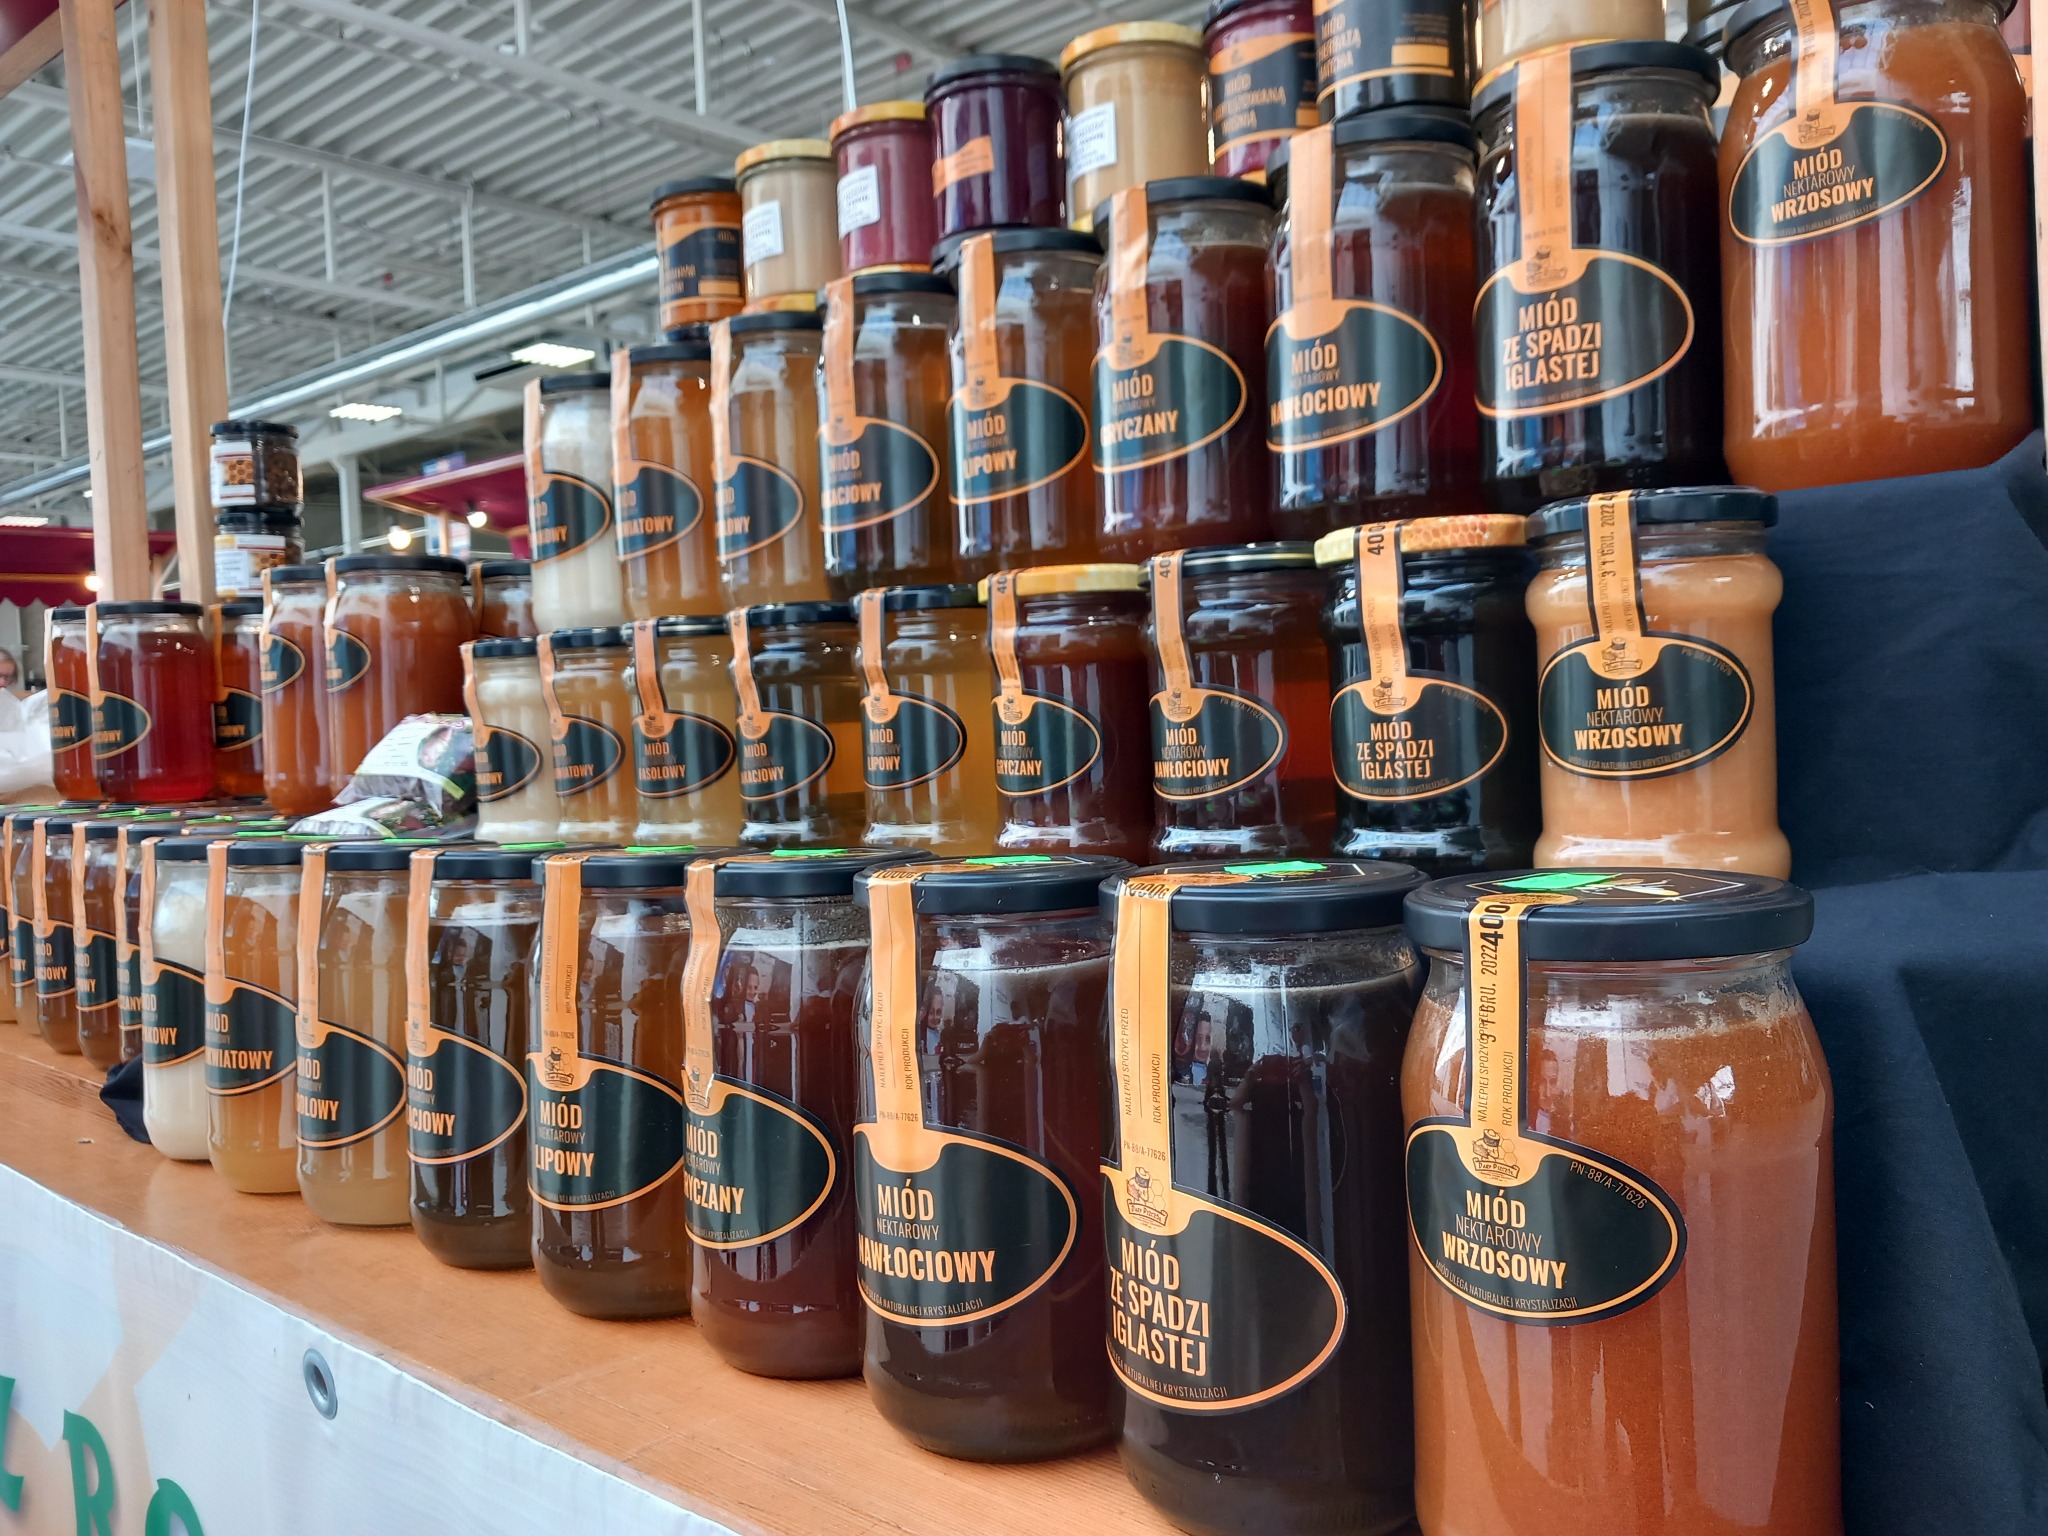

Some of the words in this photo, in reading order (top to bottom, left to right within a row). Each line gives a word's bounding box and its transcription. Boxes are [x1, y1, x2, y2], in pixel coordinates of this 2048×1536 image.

[1793, 146, 1842, 179] MIÓD
[1784, 165, 1855, 198] NEKTAROWY
[1771, 178, 1874, 224] WRZOSOWY
[1519, 291, 1578, 332] MIÓD
[1291, 339, 1337, 375] MIÓD
[1503, 336, 1522, 365] ZE
[1526, 322, 1601, 359] SPADZI
[1112, 370, 1153, 403] MIÓD
[1506, 351, 1600, 391] IGLASTEJ
[967, 411, 1005, 440] MIÓD
[1601, 503, 1614, 527] 2022
[1597, 680, 1648, 709] MIÓD
[1370, 716, 1411, 740] MIÓD
[1587, 707, 1664, 726] NEKTAROWY
[644, 738, 669, 755] MIÓD
[744, 740, 767, 757] MIÓD
[870, 724, 893, 743] MIÓD
[1001, 726, 1026, 746] MIÓD
[1166, 723, 1197, 745] MIÓD
[1357, 742, 1371, 760] ZE
[1376, 739, 1434, 760] SPADZI
[1574, 723, 1683, 750] WRZOSOWY
[1155, 758, 1229, 778] NAWŁOCIOWY
[1361, 760, 1431, 780] IGLASTEJ
[1481, 946, 1497, 975] 2022
[1120, 1008, 1128, 1036] PRZED
[902, 1028, 911, 1072] PRODUKCJI
[905, 1073, 913, 1090] ROK
[1151, 1053, 1161, 1103] PRODUKCJI
[1503, 1052, 1513, 1104] PRODUKCJI
[1123, 1074, 1132, 1116] NAJLEPIEJ
[1478, 1076, 1489, 1122] NAJLEPIEJ
[540, 1096, 582, 1129] MIÓD
[1152, 1104, 1161, 1124] ROK
[1502, 1107, 1512, 1126] ROK
[686, 1120, 718, 1158] MIÓD
[1123, 1141, 1166, 1162] PN-88/A-77626
[535, 1144, 594, 1177] LIPOWY
[878, 1178, 935, 1221] MIÓD
[1570, 1161, 1647, 1210] PN-88/A-77626
[1466, 1189, 1526, 1229] MIÓD
[876, 1218, 939, 1241] NEKTAROWY
[1456, 1214, 1542, 1254] NEKTAROWY
[858, 1232, 996, 1283] NAWŁOCIOWY
[1121, 1238, 1180, 1291] MIÓD
[1442, 1231, 1567, 1289] WRZOSOWY
[883, 1298, 922, 1316] NATURALNEJ
[923, 1298, 983, 1316] KRYSTALIZACJI
[1110, 1266, 1123, 1308] ZE
[1128, 1280, 1210, 1338] SPADZI
[1449, 1273, 1468, 1292] ULEGA
[1470, 1284, 1514, 1308] NATURALNEJ
[1515, 1297, 1578, 1310] KRYSTALIZACJI
[1113, 1305, 1207, 1377] IGLASTEJ
[1124, 1363, 1162, 1392] NATURALNEJ
[1163, 1384, 1228, 1398] KRYSTALIZACJI
